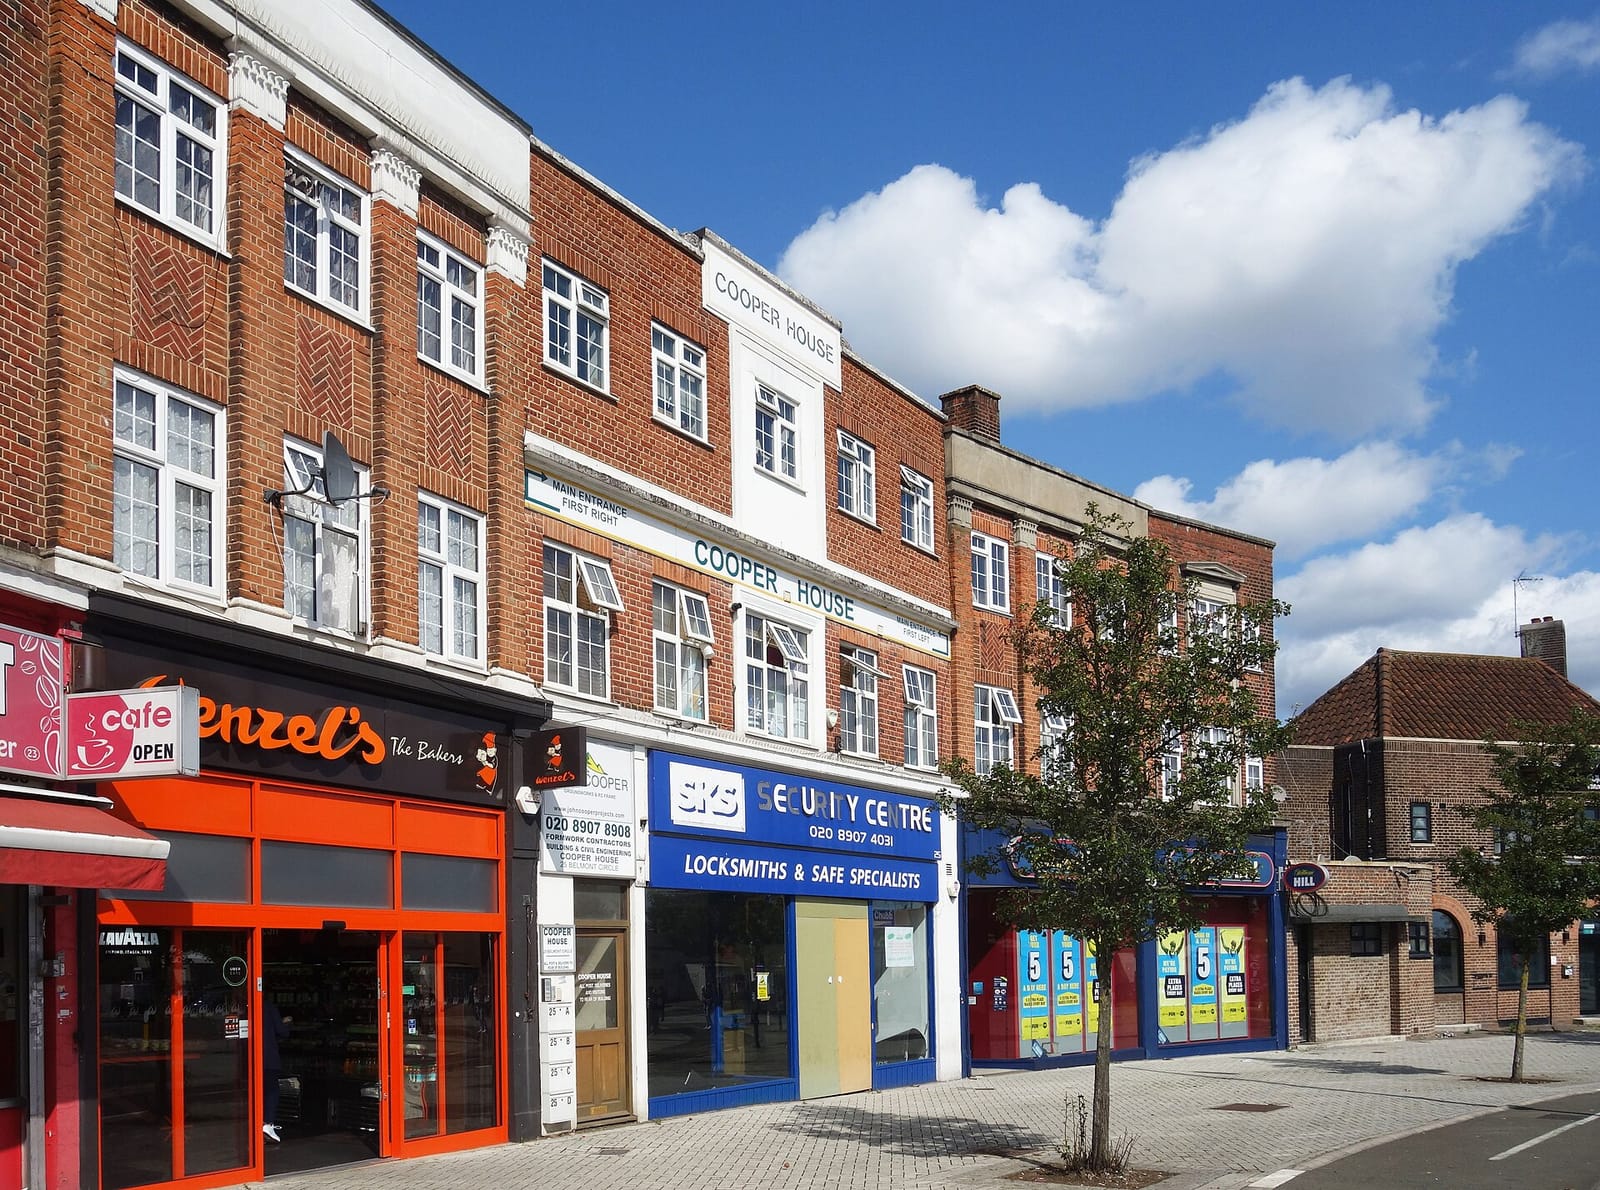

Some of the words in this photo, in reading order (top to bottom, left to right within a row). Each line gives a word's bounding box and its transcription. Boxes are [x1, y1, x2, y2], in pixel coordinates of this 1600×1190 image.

[715, 272, 780, 329] COOPER
[786, 317, 834, 364] HOUSE
[552, 481, 576, 498] MAIN
[579, 491, 628, 518] ENTRANCE
[562, 497, 589, 516] FIRST
[591, 507, 618, 527] RIGHT
[694, 539, 777, 593] COOPER
[798, 579, 855, 621] HOUSE
[903, 627, 917, 638] FIRST
[918, 633, 930, 644] LEFT
[101, 700, 172, 732] cafe
[139, 675, 386, 765] enzel's
[390, 736, 413, 756] The
[417, 741, 464, 765] Bakers
[133, 743, 174, 760] OPEN
[678, 779, 739, 818] SKS
[865, 800, 932, 833] CENTRE
[545, 816, 568, 831] 020
[572, 820, 600, 835] 8907
[604, 823, 631, 838] 8908
[809, 825, 833, 840] 020
[838, 829, 867, 844] 8907
[870, 833, 894, 847] 4031
[546, 834, 585, 843] FORMWORK
[586, 838, 631, 847] CONTRACTORS
[546, 843, 574, 852] BUILDING
[596, 848, 632, 857] ENGINEERING
[560, 853, 591, 862] COOPER
[595, 856, 619, 864] HOUSE
[569, 862, 597, 870] BELMONT
[598, 864, 619, 872] CIRCLE
[684, 855, 787, 880] LOCKSMITHS
[794, 864, 804, 881] &
[811, 865, 844, 884] SAFE
[850, 868, 920, 889] SPECIALISTS
[1293, 877, 1316, 887] HILL
[98, 928, 160, 946] LAVAZZA
[543, 927, 572, 936] COOPER
[1028, 951, 1041, 982] 5
[1061, 950, 1074, 981] 5
[1196, 946, 1211, 980] 5
[549, 1007, 557, 1017] 25
[566, 1007, 570, 1015] A
[550, 1038, 557, 1047] 25
[566, 1037, 570, 1045] B
[551, 1068, 558, 1077] 25
[567, 1066, 571, 1075] C
[551, 1098, 558, 1107] 25
